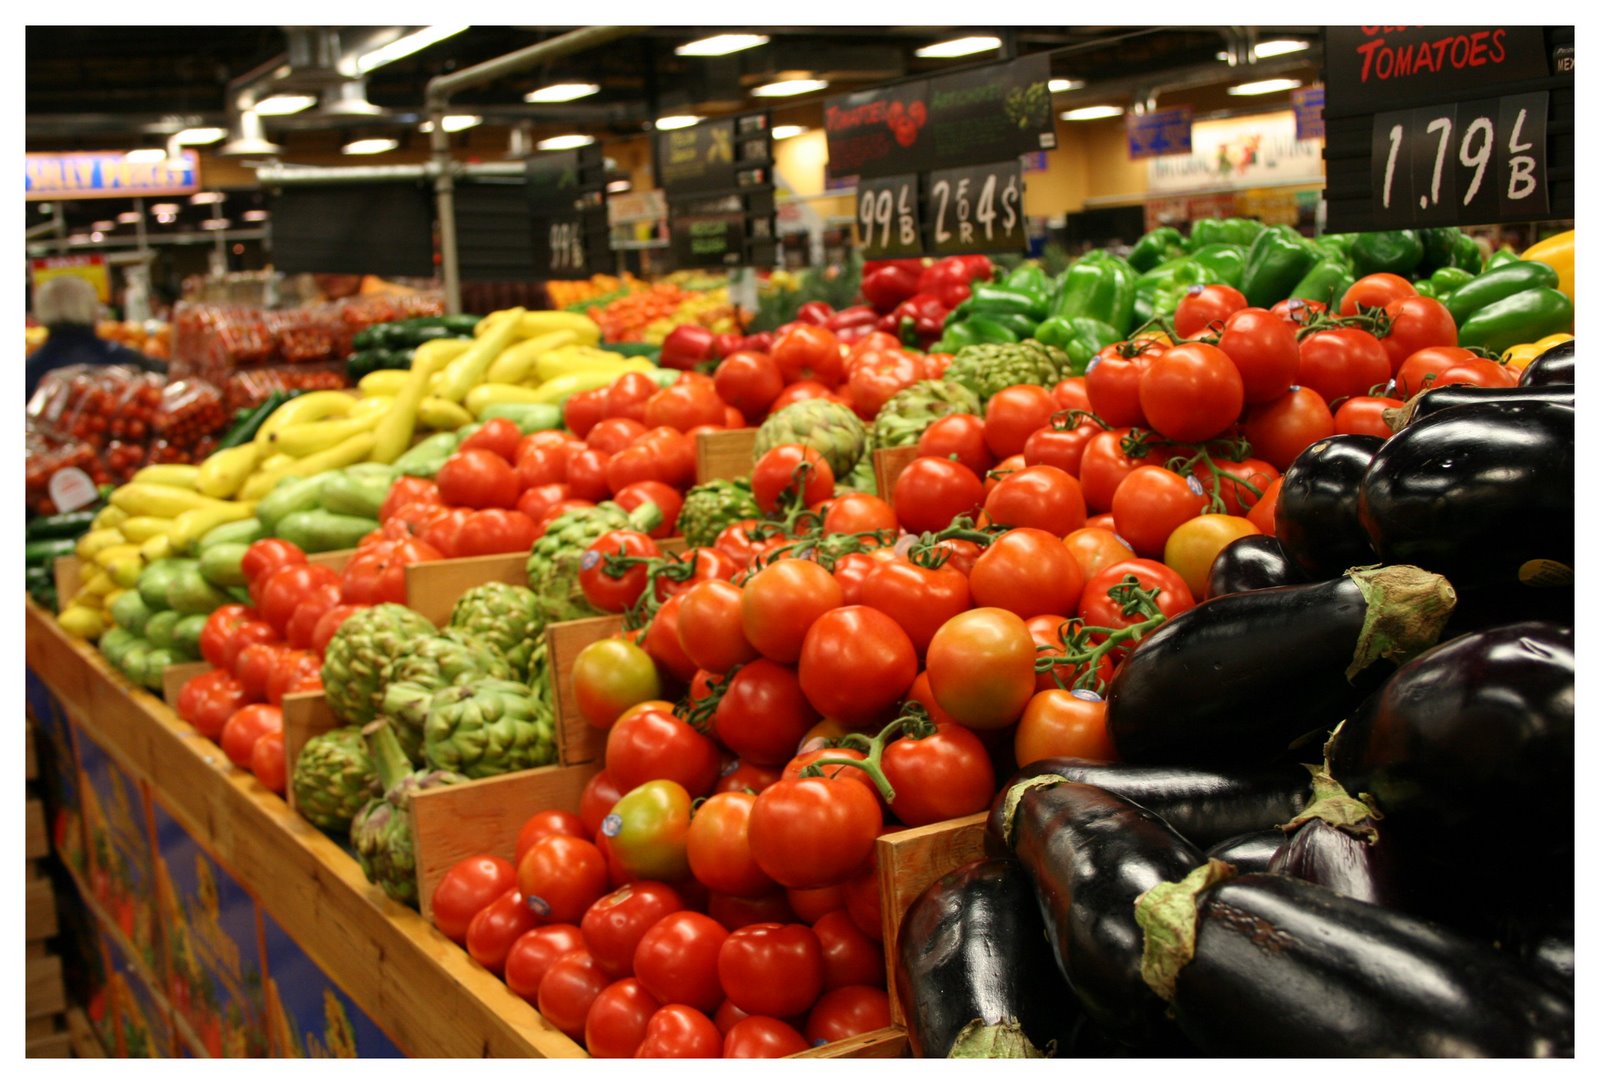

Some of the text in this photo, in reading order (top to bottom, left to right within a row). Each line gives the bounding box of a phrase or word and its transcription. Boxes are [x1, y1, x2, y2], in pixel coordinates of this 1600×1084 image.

[1356, 29, 1507, 82] TOMATOES
[1382, 116, 1494, 209] 1.79
[860, 189, 893, 248] 99
[932, 180, 951, 244] 2
